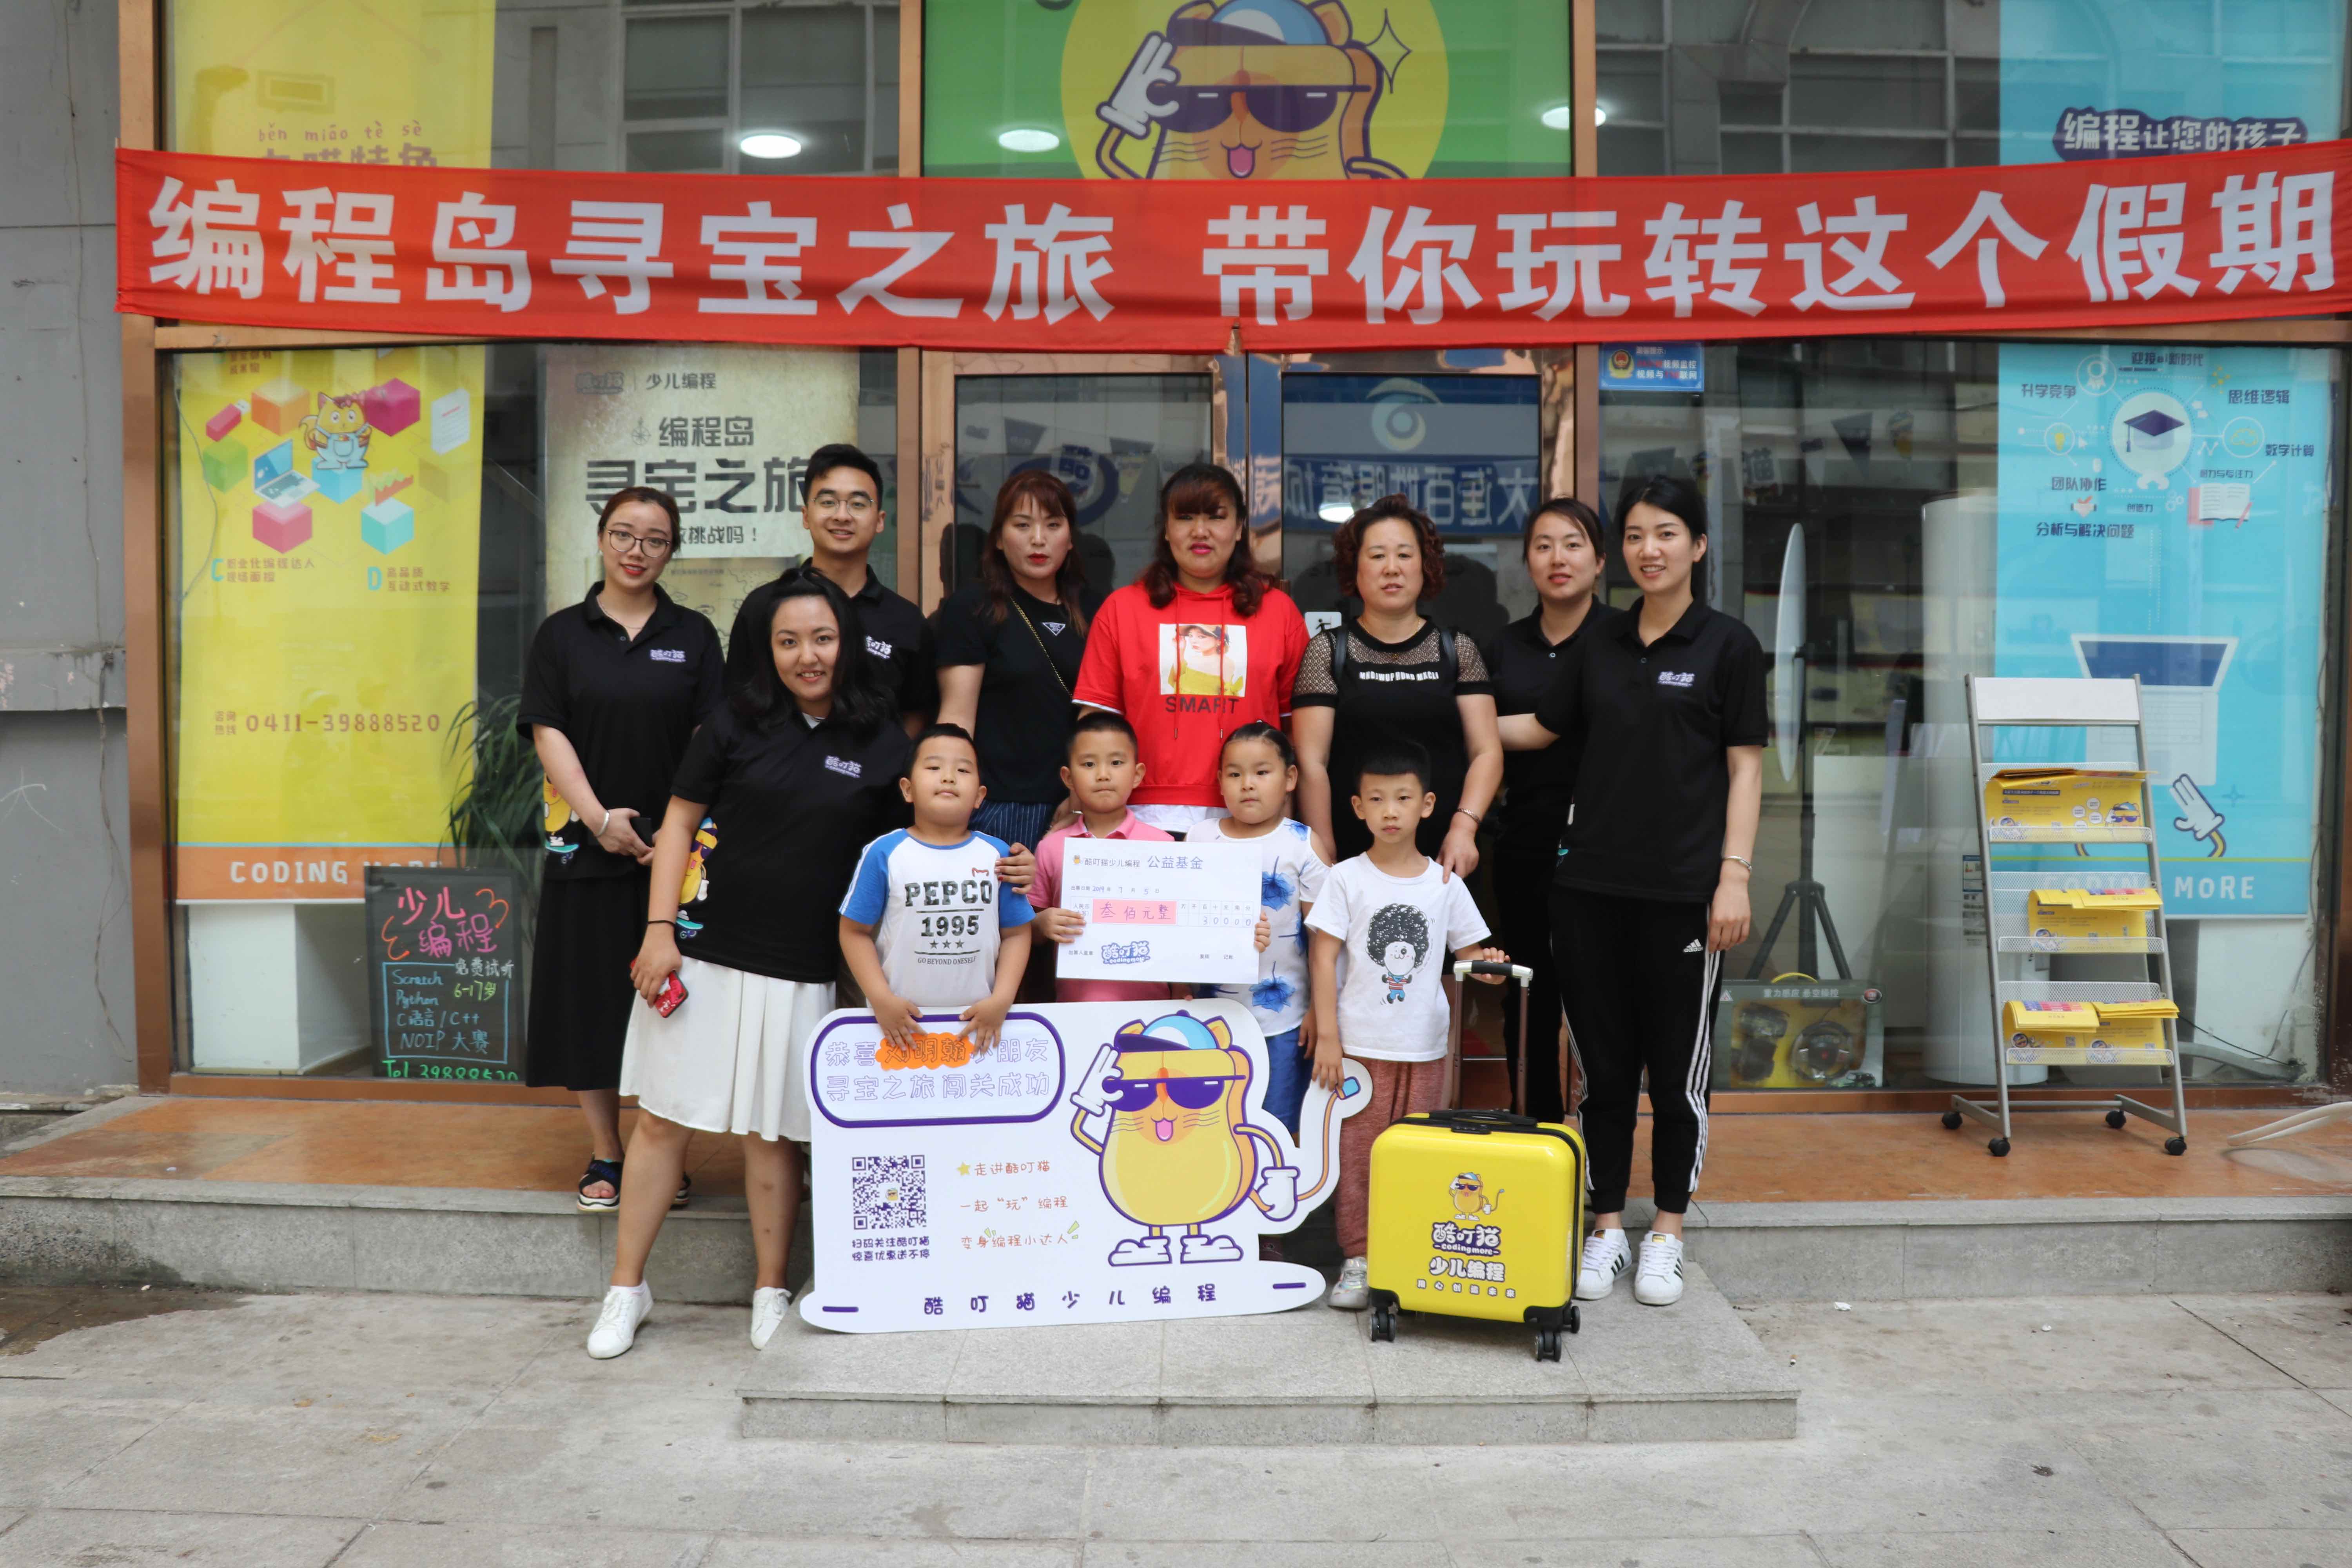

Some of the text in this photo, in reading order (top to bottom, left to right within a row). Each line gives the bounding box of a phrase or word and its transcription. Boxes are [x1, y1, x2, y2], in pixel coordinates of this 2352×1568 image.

[149, 170, 2336, 326] 编程岛寻宝之旅 带你玩转这个假期
[645, 372, 717, 390] 少儿编程
[2021, 383, 2076, 399] 升学竞争
[2228, 389, 2290, 405] 思维逻辑
[659, 416, 754, 447] 编程岛
[2051, 477, 2107, 492] 团队协作
[2036, 522, 2135, 539] 分析与解决问题
[367, 566, 383, 590] D
[245, 713, 439, 732] 0411-39888520
[230, 860, 348, 884] CODING
[1084, 856, 1203, 869] 酷叮猫少儿编程 公益基金
[904, 879, 993, 907] PEPCO
[2175, 875, 2254, 900] MORE
[398, 886, 466, 926] 少儿
[419, 914, 497, 958] 编程
[921, 915, 980, 937] 1995
[927, 957, 952, 965] BEYOND
[952, 956, 976, 965] ONESELF
[1102, 942, 1150, 960] 酷叮猫
[455, 957, 515, 978] 免费试听
[396, 989, 439, 1008] Python
[400, 1029, 490, 1054] NOIP 大赛
[826, 1071, 1049, 1102] 寻宝之旅闯关成功
[974, 1160, 1051, 1176] 走进酷叮猫
[852, 1236, 930, 1249] 扫码关注酷叮猫
[960, 1233, 1068, 1250] 变身编程小达人
[1433, 1222, 1501, 1247] 酷叮猫
[852, 1249, 930, 1262] 惊喜优惠送不停
[1429, 1256, 1505, 1282] 少儿编程
[1417, 1278, 1516, 1299] 用心创造未来
[924, 1282, 1217, 1317] 酷叮猫少儿编程
